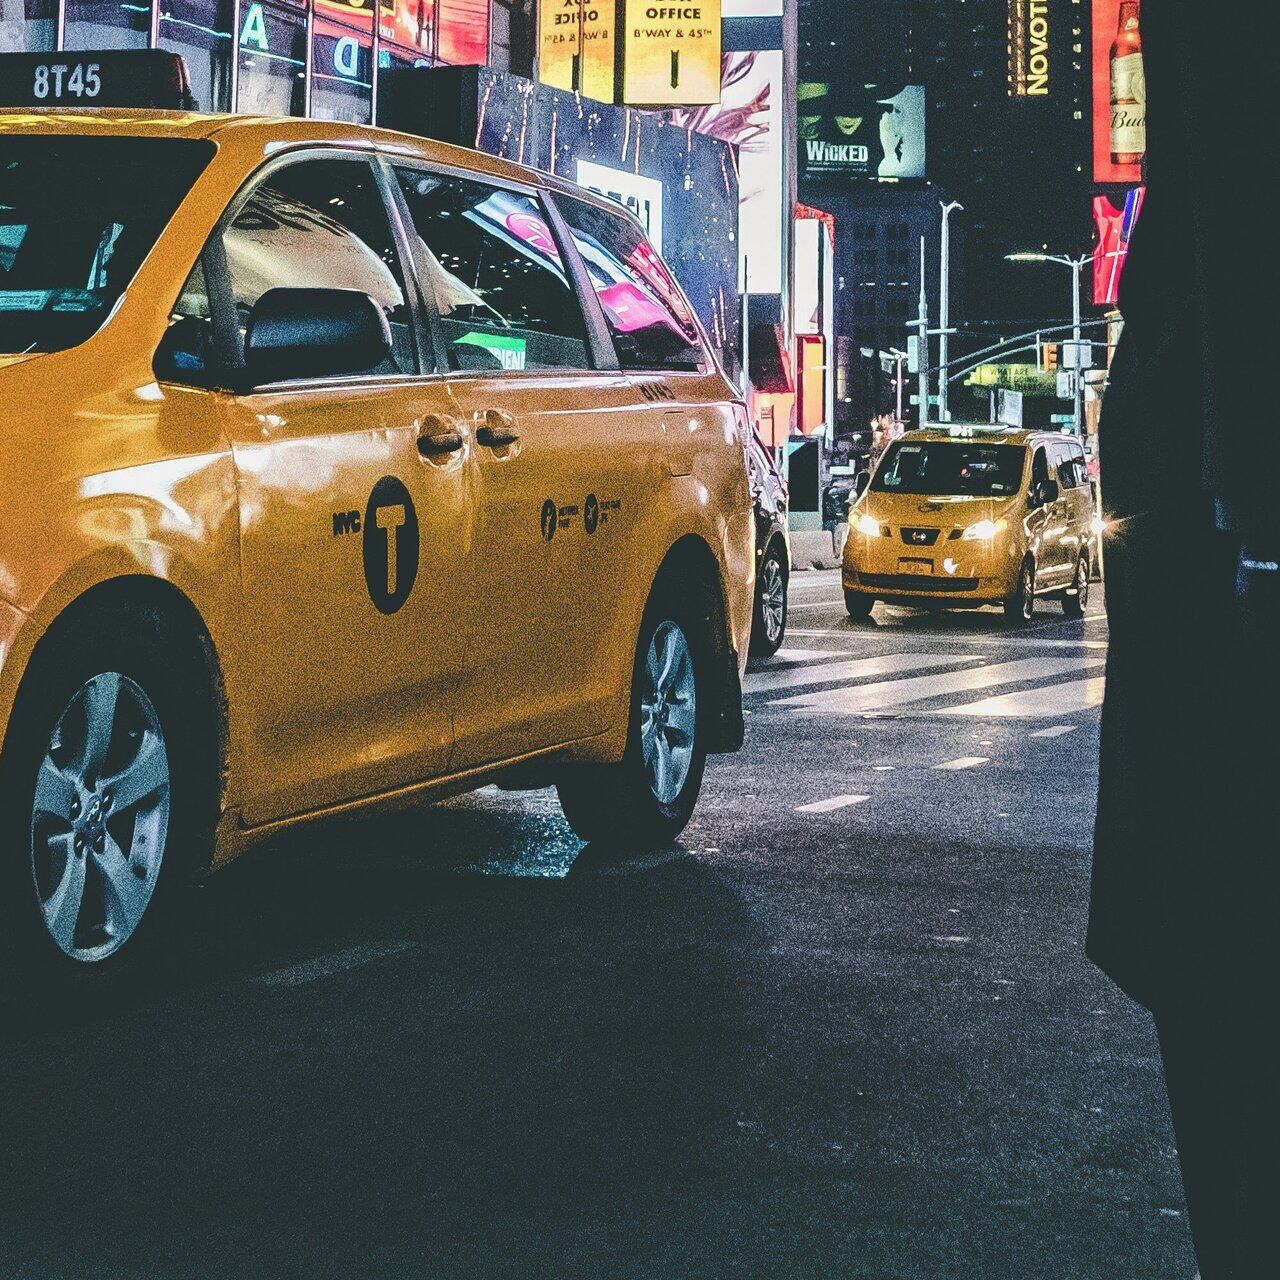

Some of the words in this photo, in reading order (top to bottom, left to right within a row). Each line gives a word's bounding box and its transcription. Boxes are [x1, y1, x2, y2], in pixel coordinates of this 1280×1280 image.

[646, 8, 701, 19] OFFICE
[32, 62, 101, 98] 8T45
[332, 510, 361, 538] NYC
